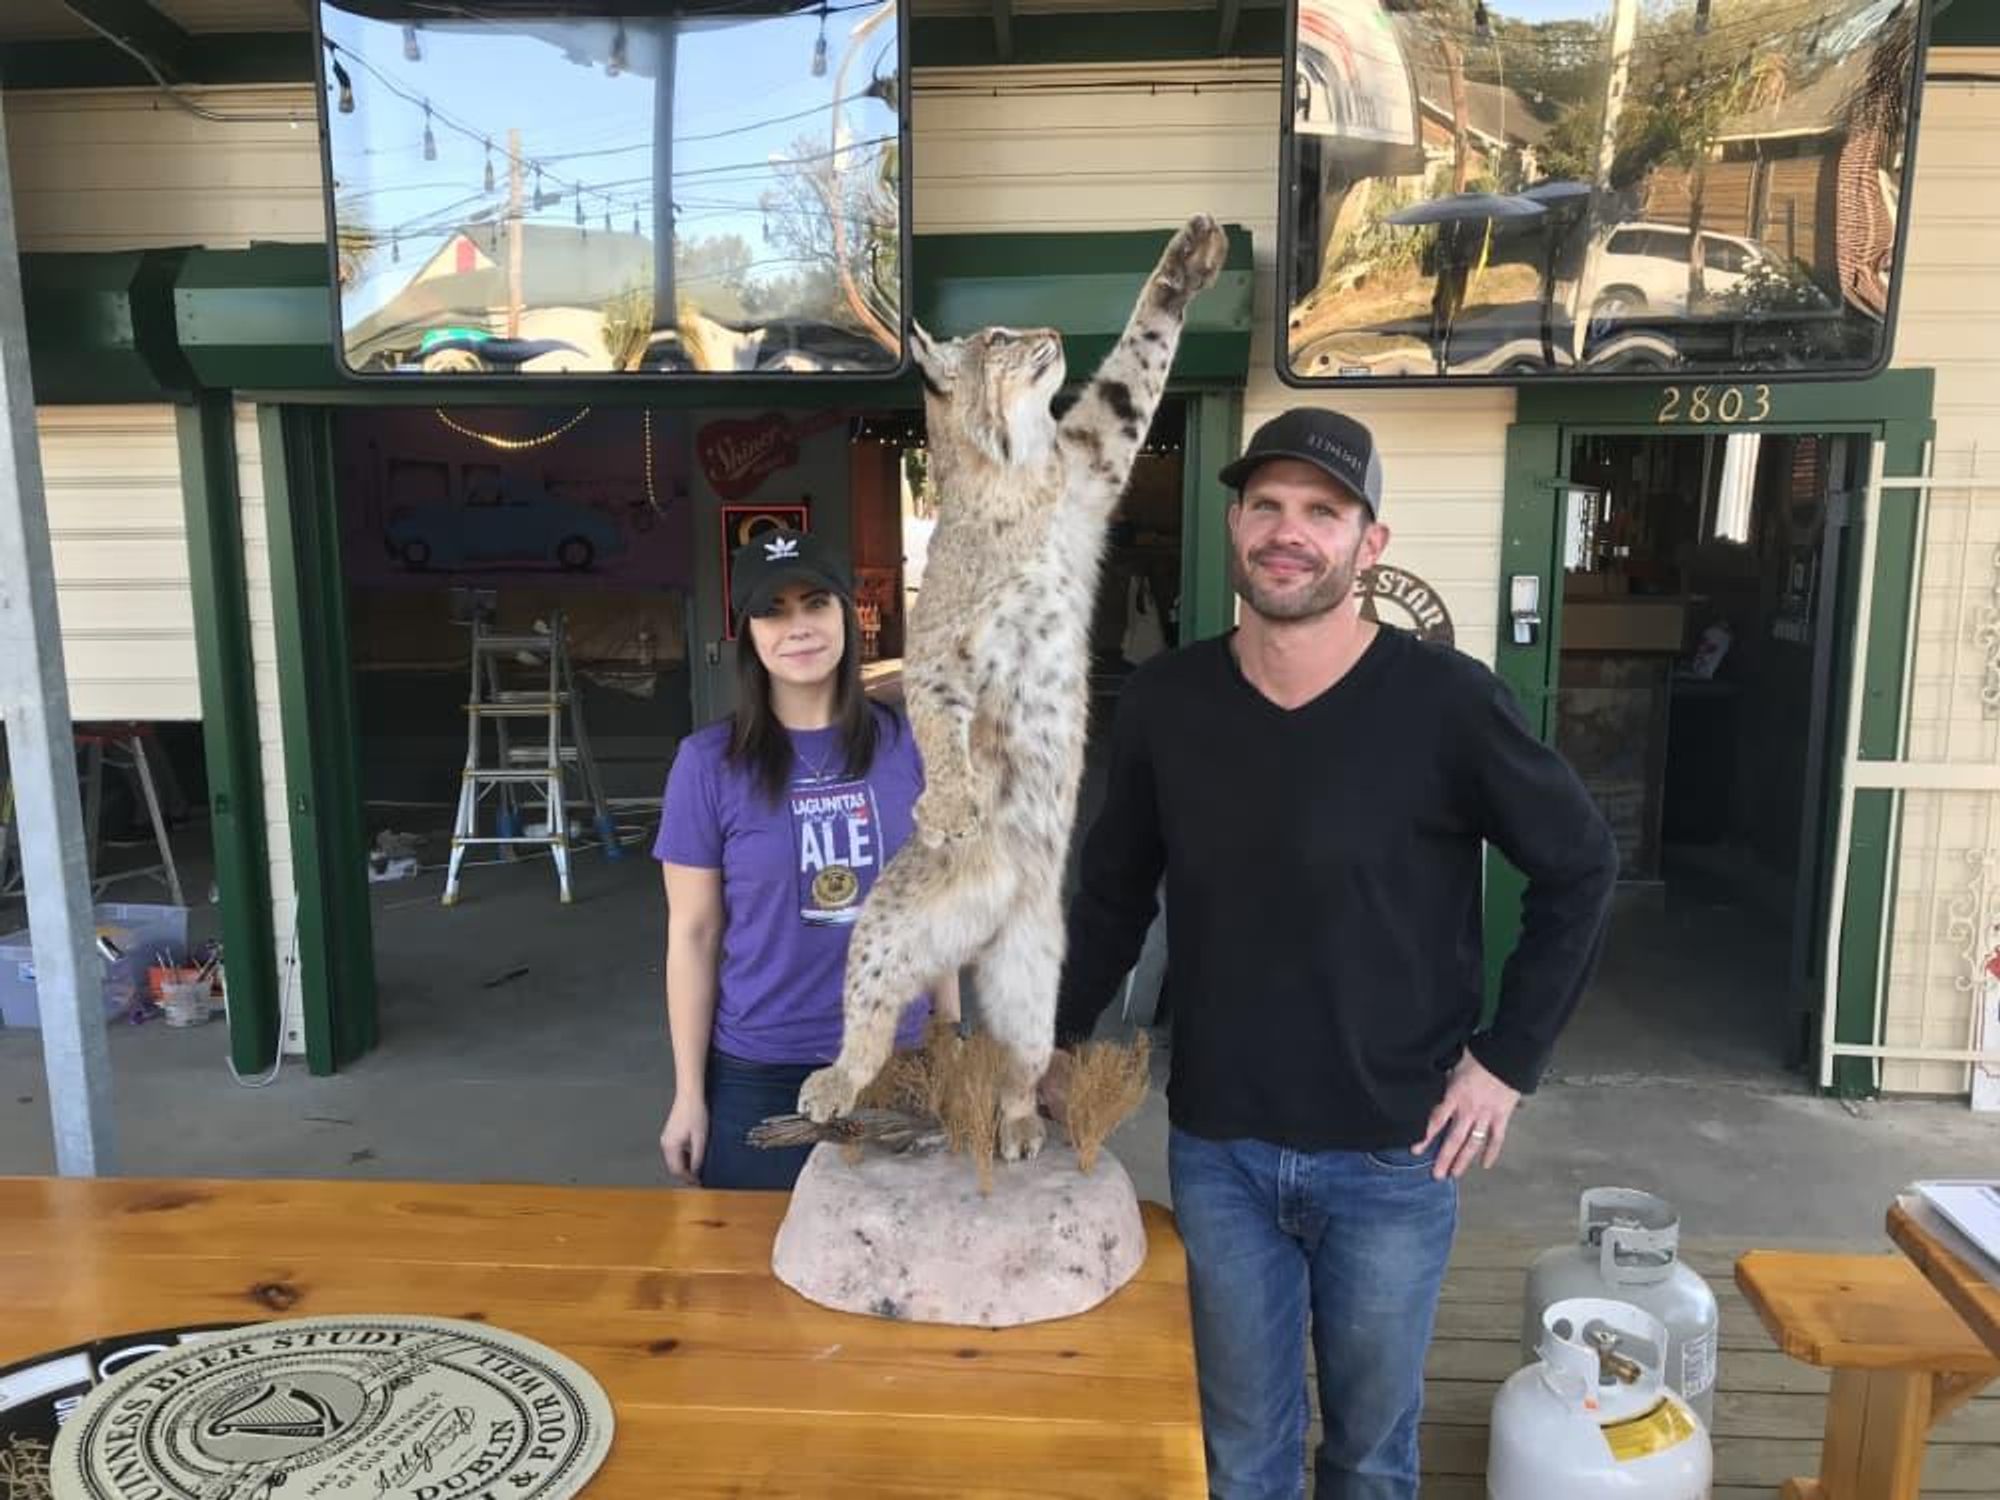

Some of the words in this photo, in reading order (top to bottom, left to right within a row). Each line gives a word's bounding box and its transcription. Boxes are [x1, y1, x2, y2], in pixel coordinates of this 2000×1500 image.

[1658, 384, 1770, 422] 2803
[791, 792, 866, 815] LAGUNITAS
[801, 817, 873, 873] ALE
[478, 1351, 545, 1395] WELL
[103, 1399, 173, 1500] UINNESS
[145, 1344, 255, 1392] BEER
[273, 1331, 416, 1349] STUDY
[529, 1393, 566, 1461] POUR
[336, 1450, 367, 1470] THE
[411, 1419, 516, 1500] DUBLIN
[508, 1471, 540, 1488] &
